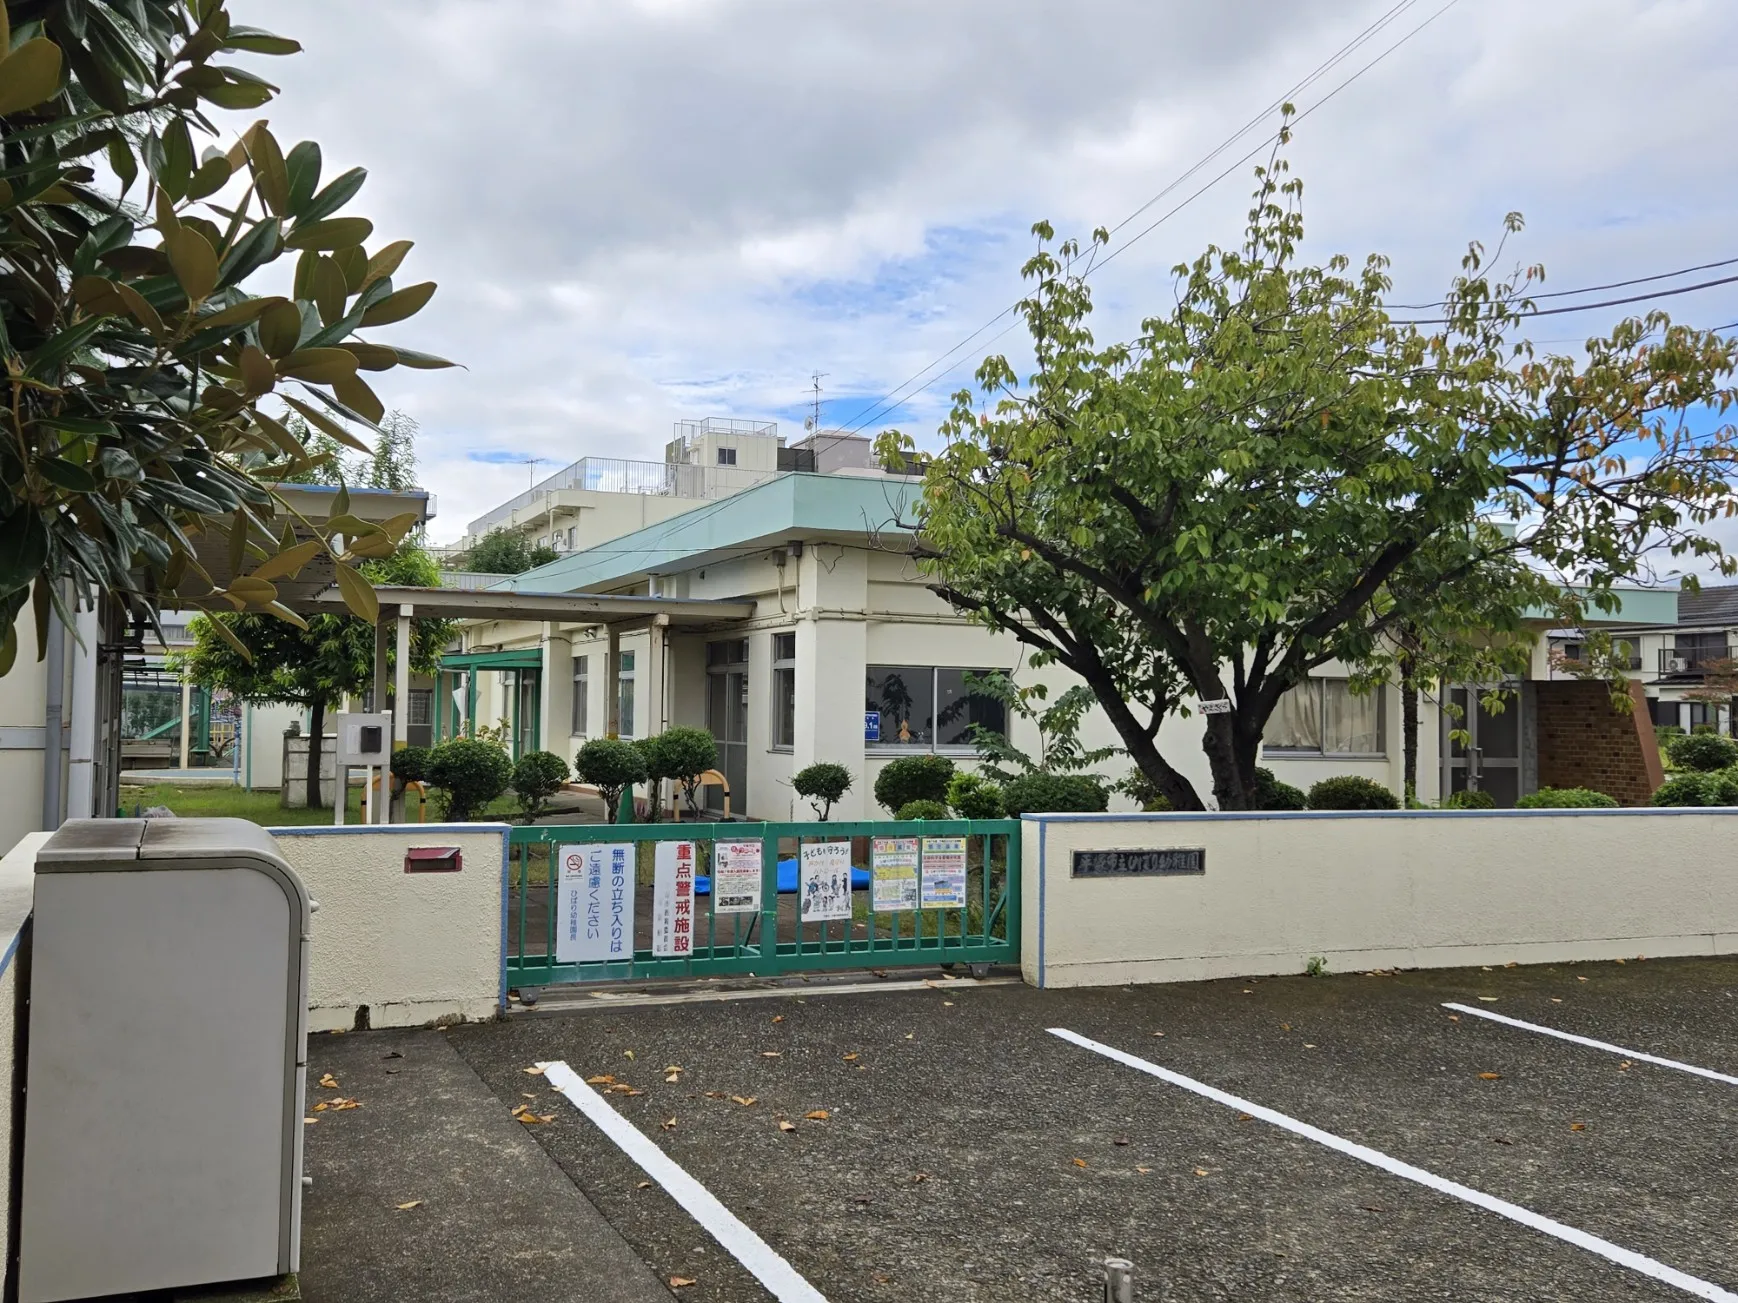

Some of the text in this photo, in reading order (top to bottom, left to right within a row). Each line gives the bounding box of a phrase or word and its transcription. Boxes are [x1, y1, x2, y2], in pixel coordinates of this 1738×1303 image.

[587, 849, 602, 940] ご遠慮ください
[610, 849, 625, 953] 無断の立ち入りは
[673, 843, 692, 952] 重点警戒施設
